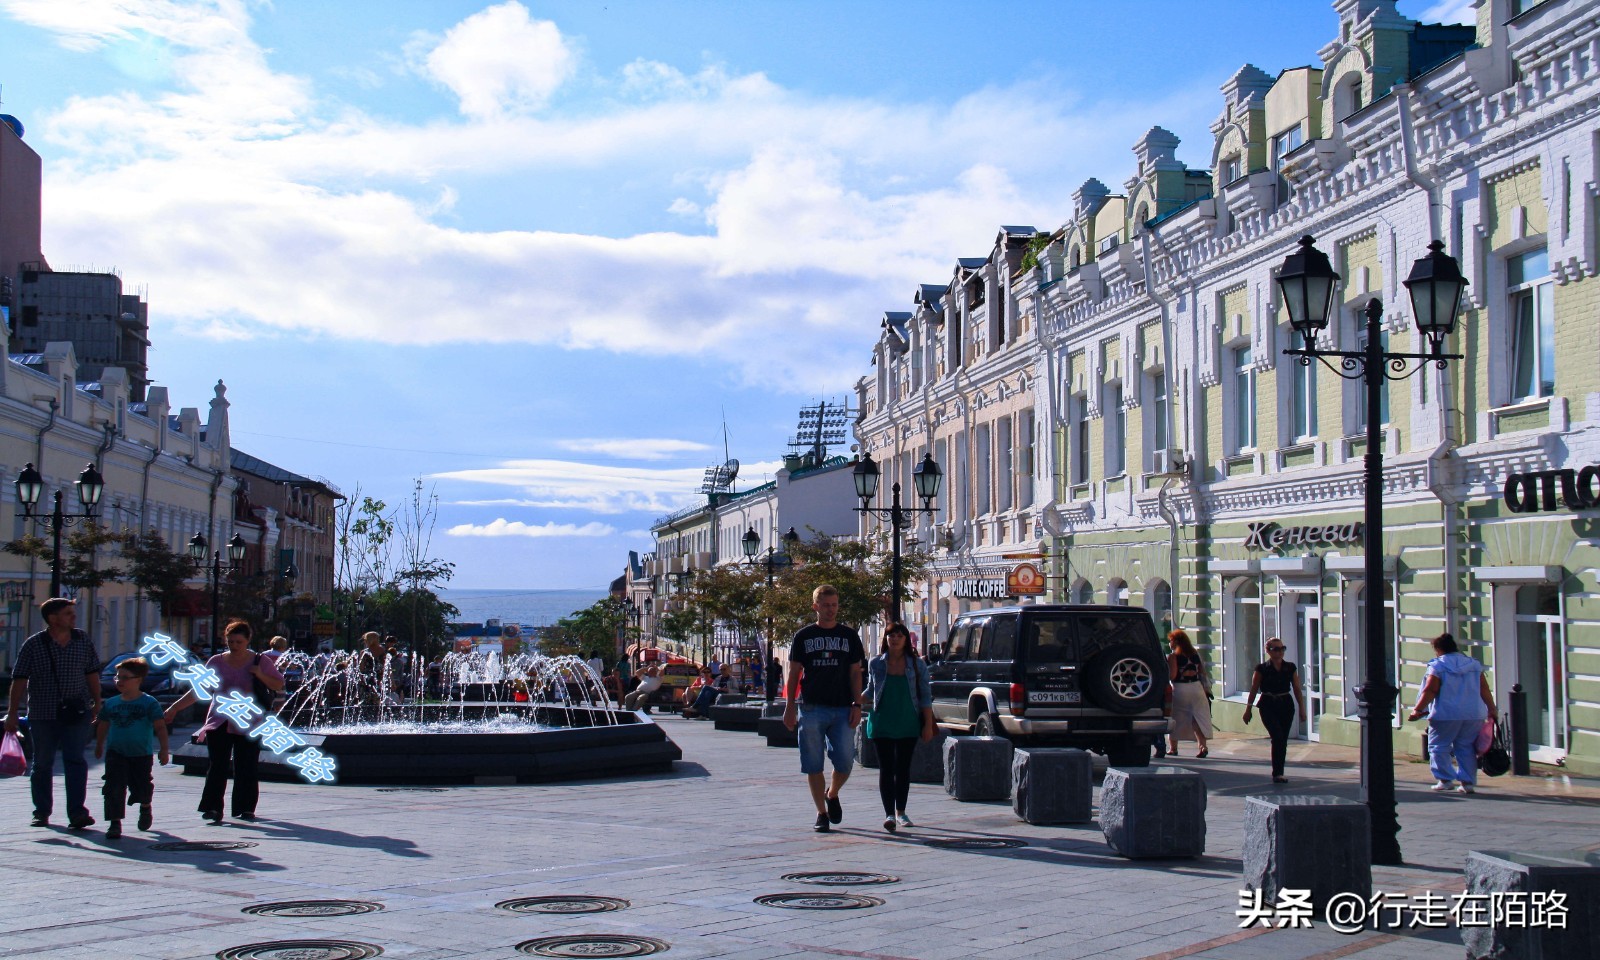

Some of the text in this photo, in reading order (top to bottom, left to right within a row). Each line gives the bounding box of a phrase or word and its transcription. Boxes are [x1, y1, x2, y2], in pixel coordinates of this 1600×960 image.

[1243, 521, 1361, 551] Женева
[952, 579, 977, 597] PIRATE
[978, 578, 1009, 598] COFFE
[804, 636, 850, 653] ROMA
